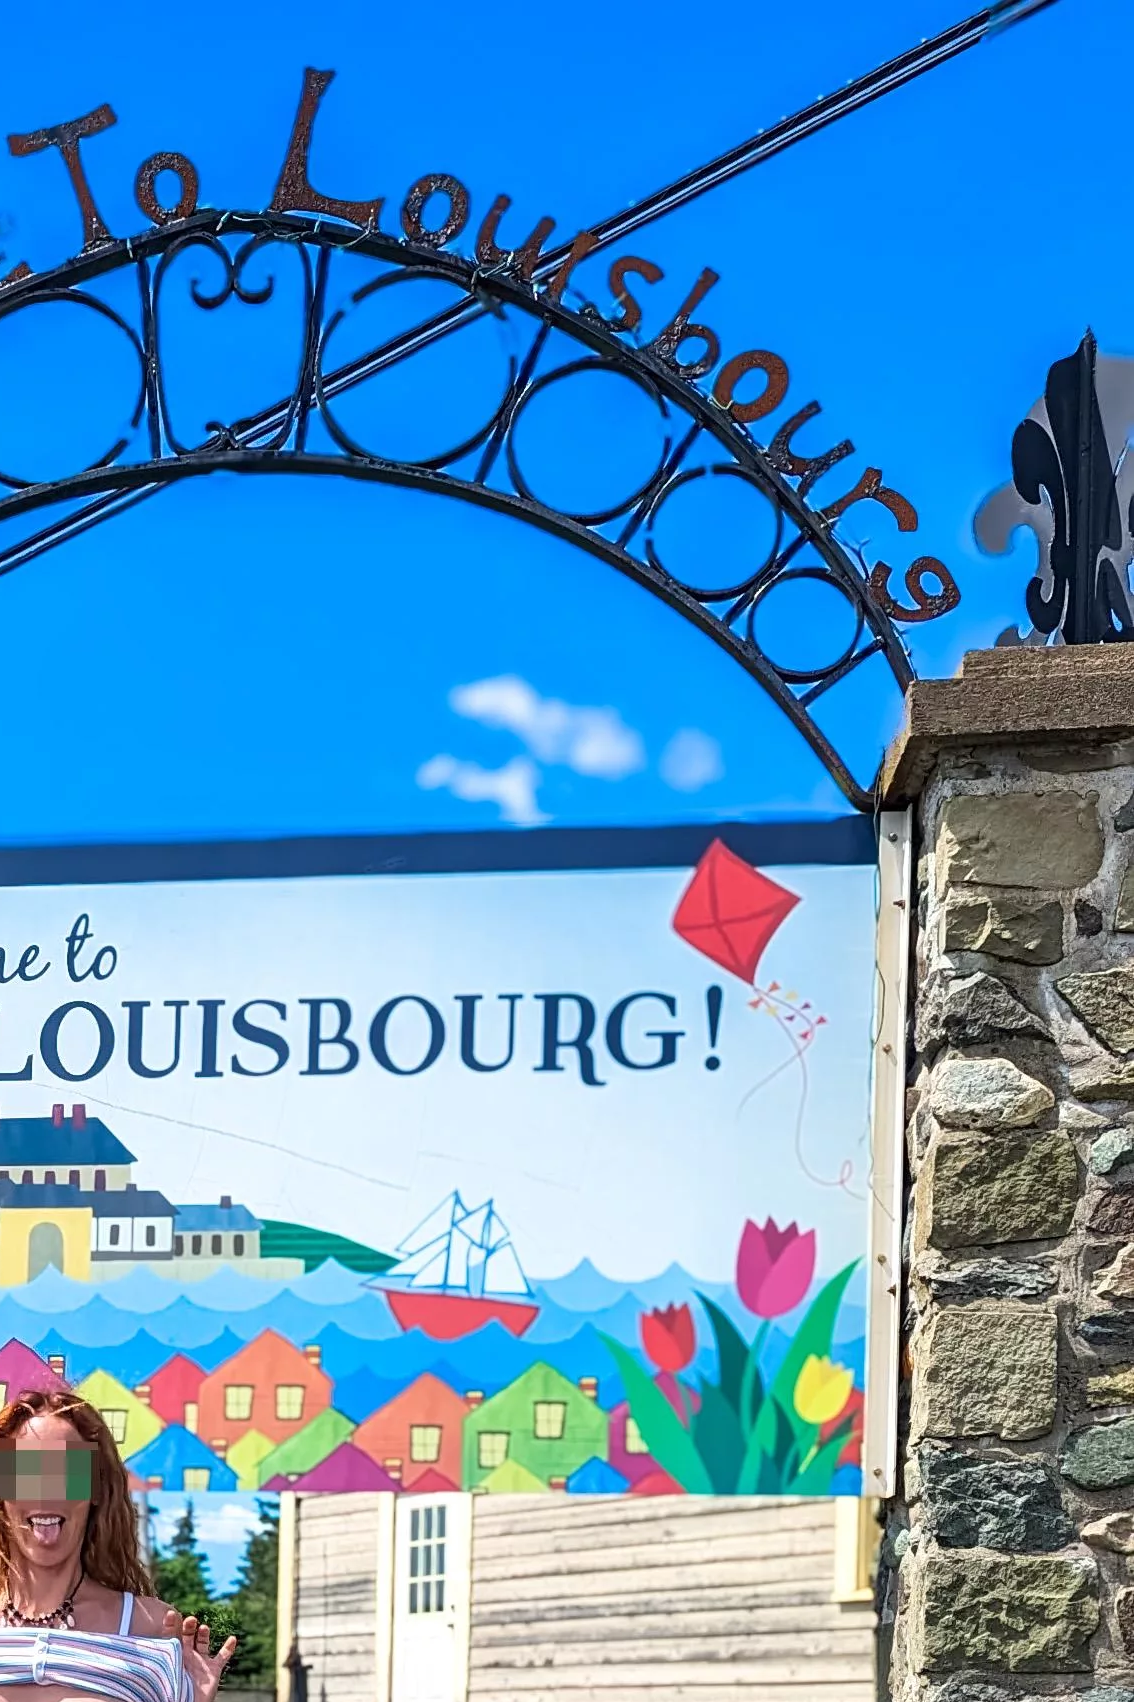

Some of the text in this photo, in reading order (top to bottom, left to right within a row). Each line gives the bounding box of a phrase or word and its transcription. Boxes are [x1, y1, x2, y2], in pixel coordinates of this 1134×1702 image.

[6, 102, 199, 257] To
[267, 66, 962, 622] Louisbourg
[65, 912, 118, 983] to
